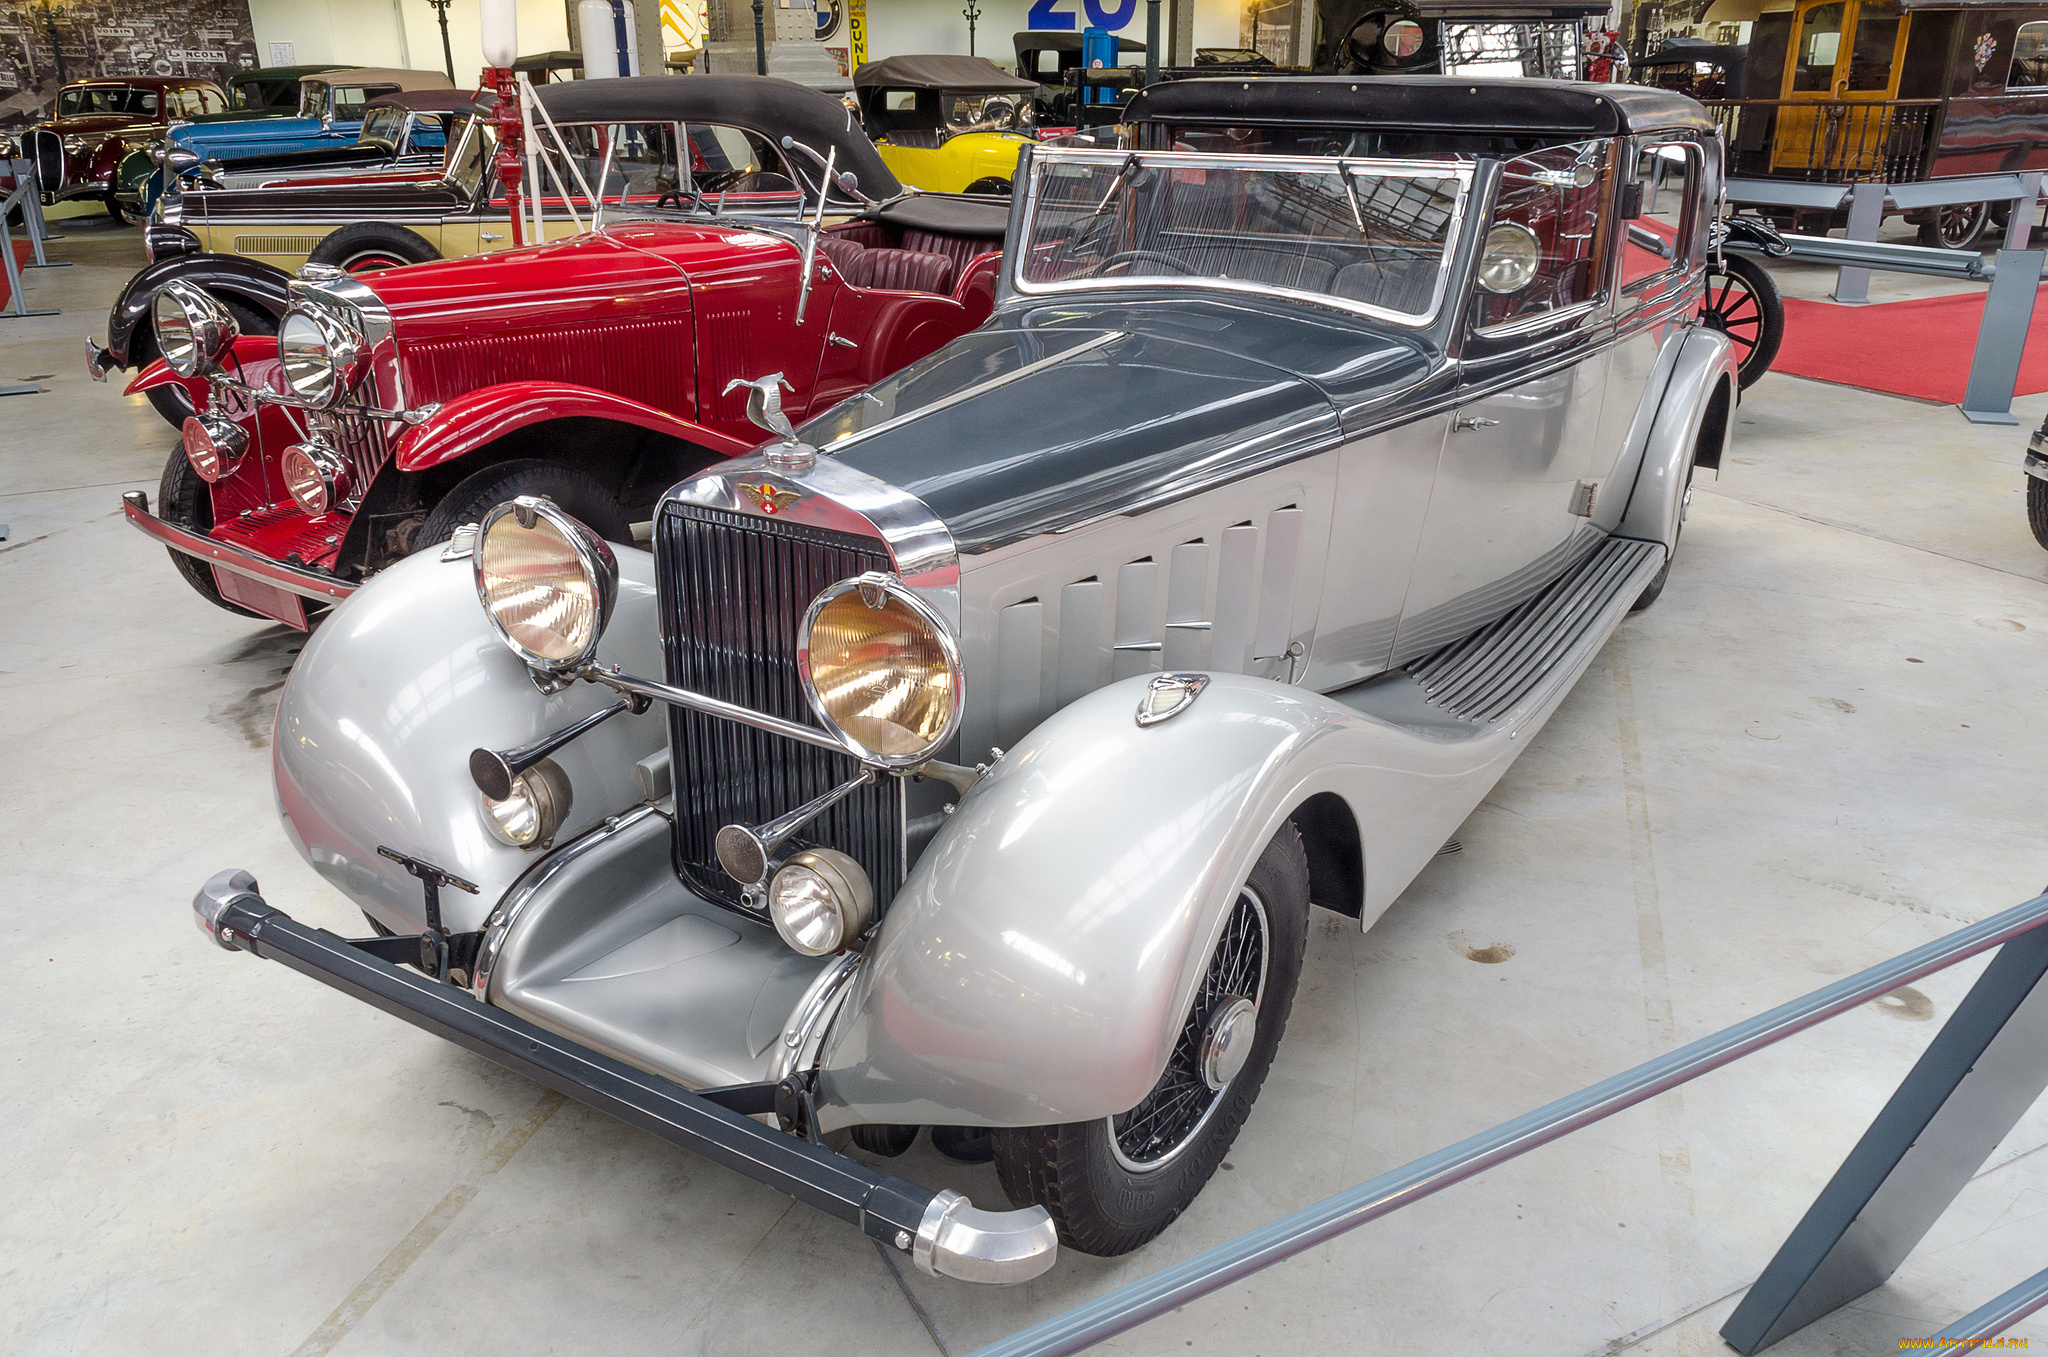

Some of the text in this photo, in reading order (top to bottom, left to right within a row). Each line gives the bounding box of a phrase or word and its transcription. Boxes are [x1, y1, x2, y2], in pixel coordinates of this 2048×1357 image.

[38, 46, 87, 56] AMLCAR
[167, 49, 224, 59] LNCOLN
[1178, 1092, 1247, 1191] DUNLOP
[1118, 1187, 1156, 1214] CORD
